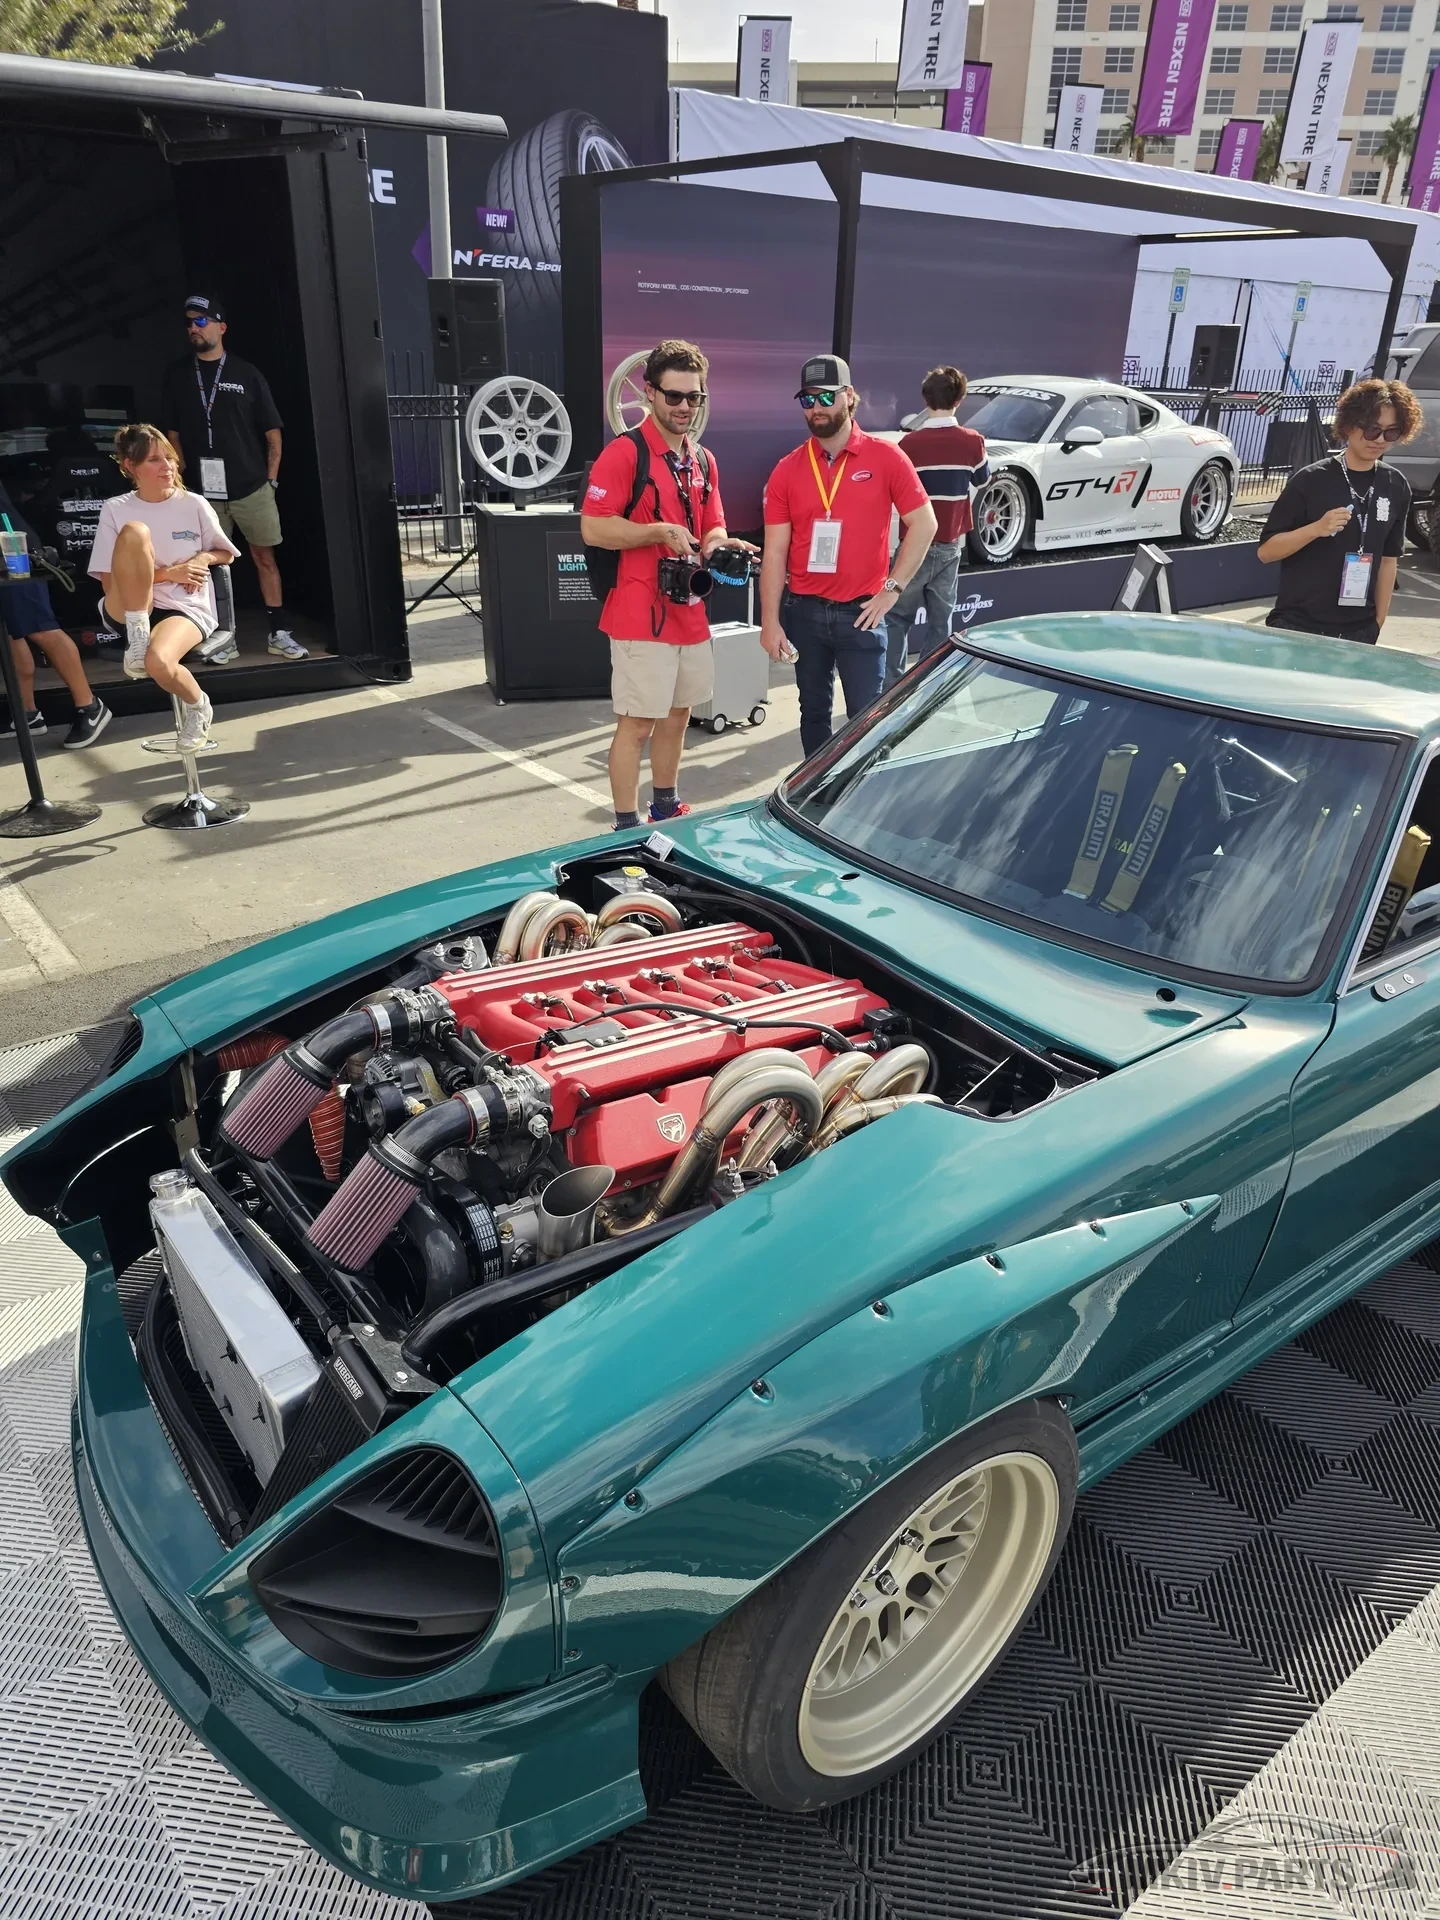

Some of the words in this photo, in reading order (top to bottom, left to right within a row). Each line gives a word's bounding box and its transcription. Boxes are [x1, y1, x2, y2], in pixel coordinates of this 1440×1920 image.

[923, 32, 940, 80] TIRE
[1166, 22, 1189, 84] NEXEN
[1311, 61, 1333, 116] NEXEN
[1157, 88, 1177, 128] TIRE
[1302, 120, 1320, 156] TIRE
[368, 169, 397, 205] E
[485, 213, 508, 228] NEW!
[218, 382, 244, 390] MOZA
[1045, 470, 1138, 502] GT4R
[1147, 489, 1180, 501] MOTUL
[557, 554, 573, 562] WE
[1085, 793, 1115, 859] BRAUM
[1128, 807, 1165, 873] BRAUM
[334, 1358, 363, 1399] VIBRANT
